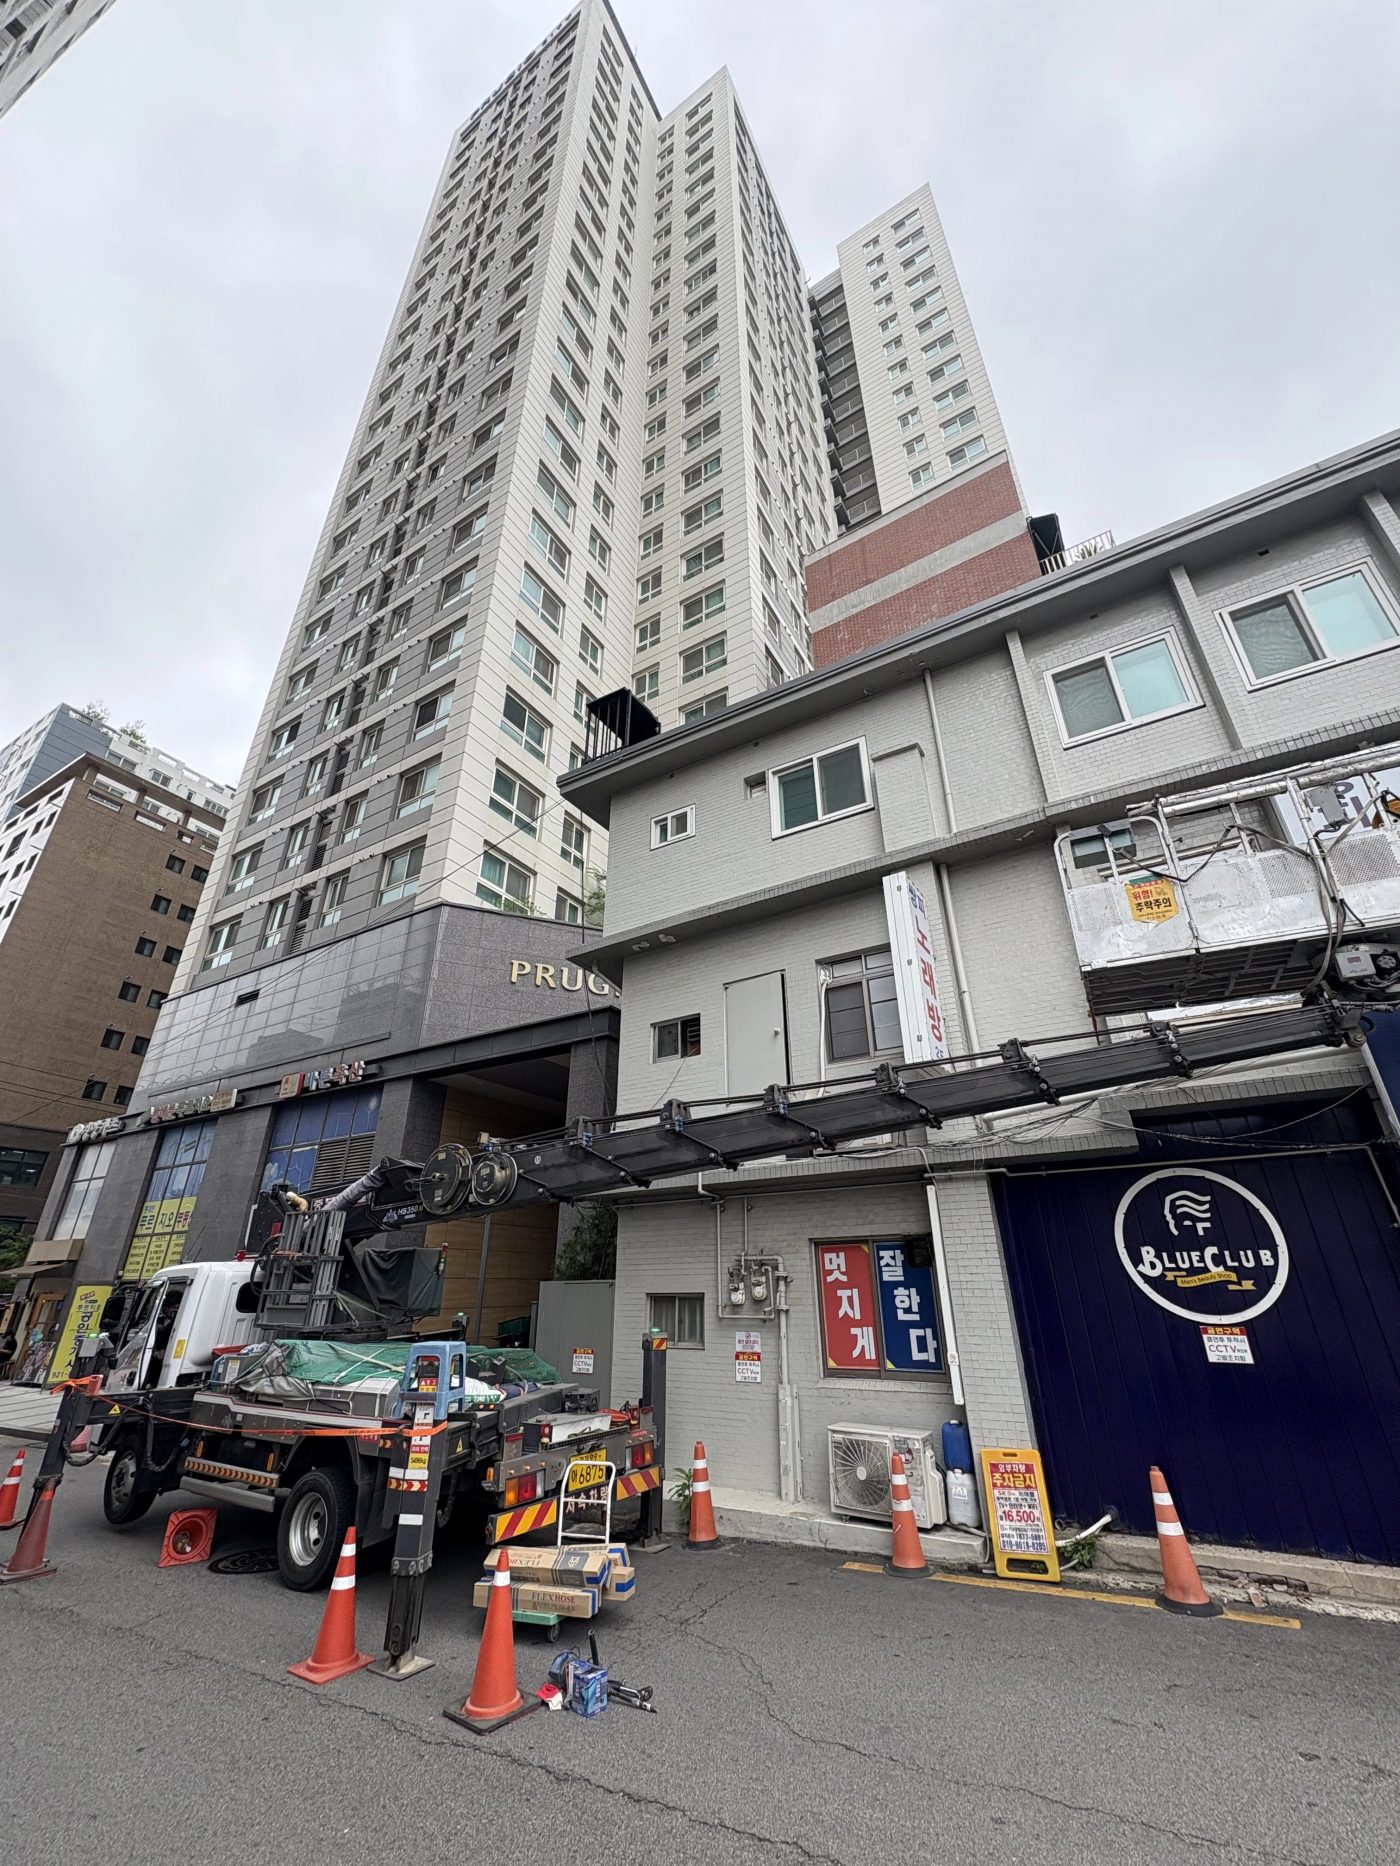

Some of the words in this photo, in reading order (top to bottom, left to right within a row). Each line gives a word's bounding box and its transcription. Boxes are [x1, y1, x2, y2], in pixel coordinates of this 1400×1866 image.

[1132, 888, 1153, 901] 위험!
[1134, 897, 1172, 912] 추락주의
[510, 959, 620, 998] PRUG
[578, 1464, 604, 1485] 6875
[992, 1472, 1036, 1488] 주차금지
[1002, 1509, 1036, 1524] 16,500
